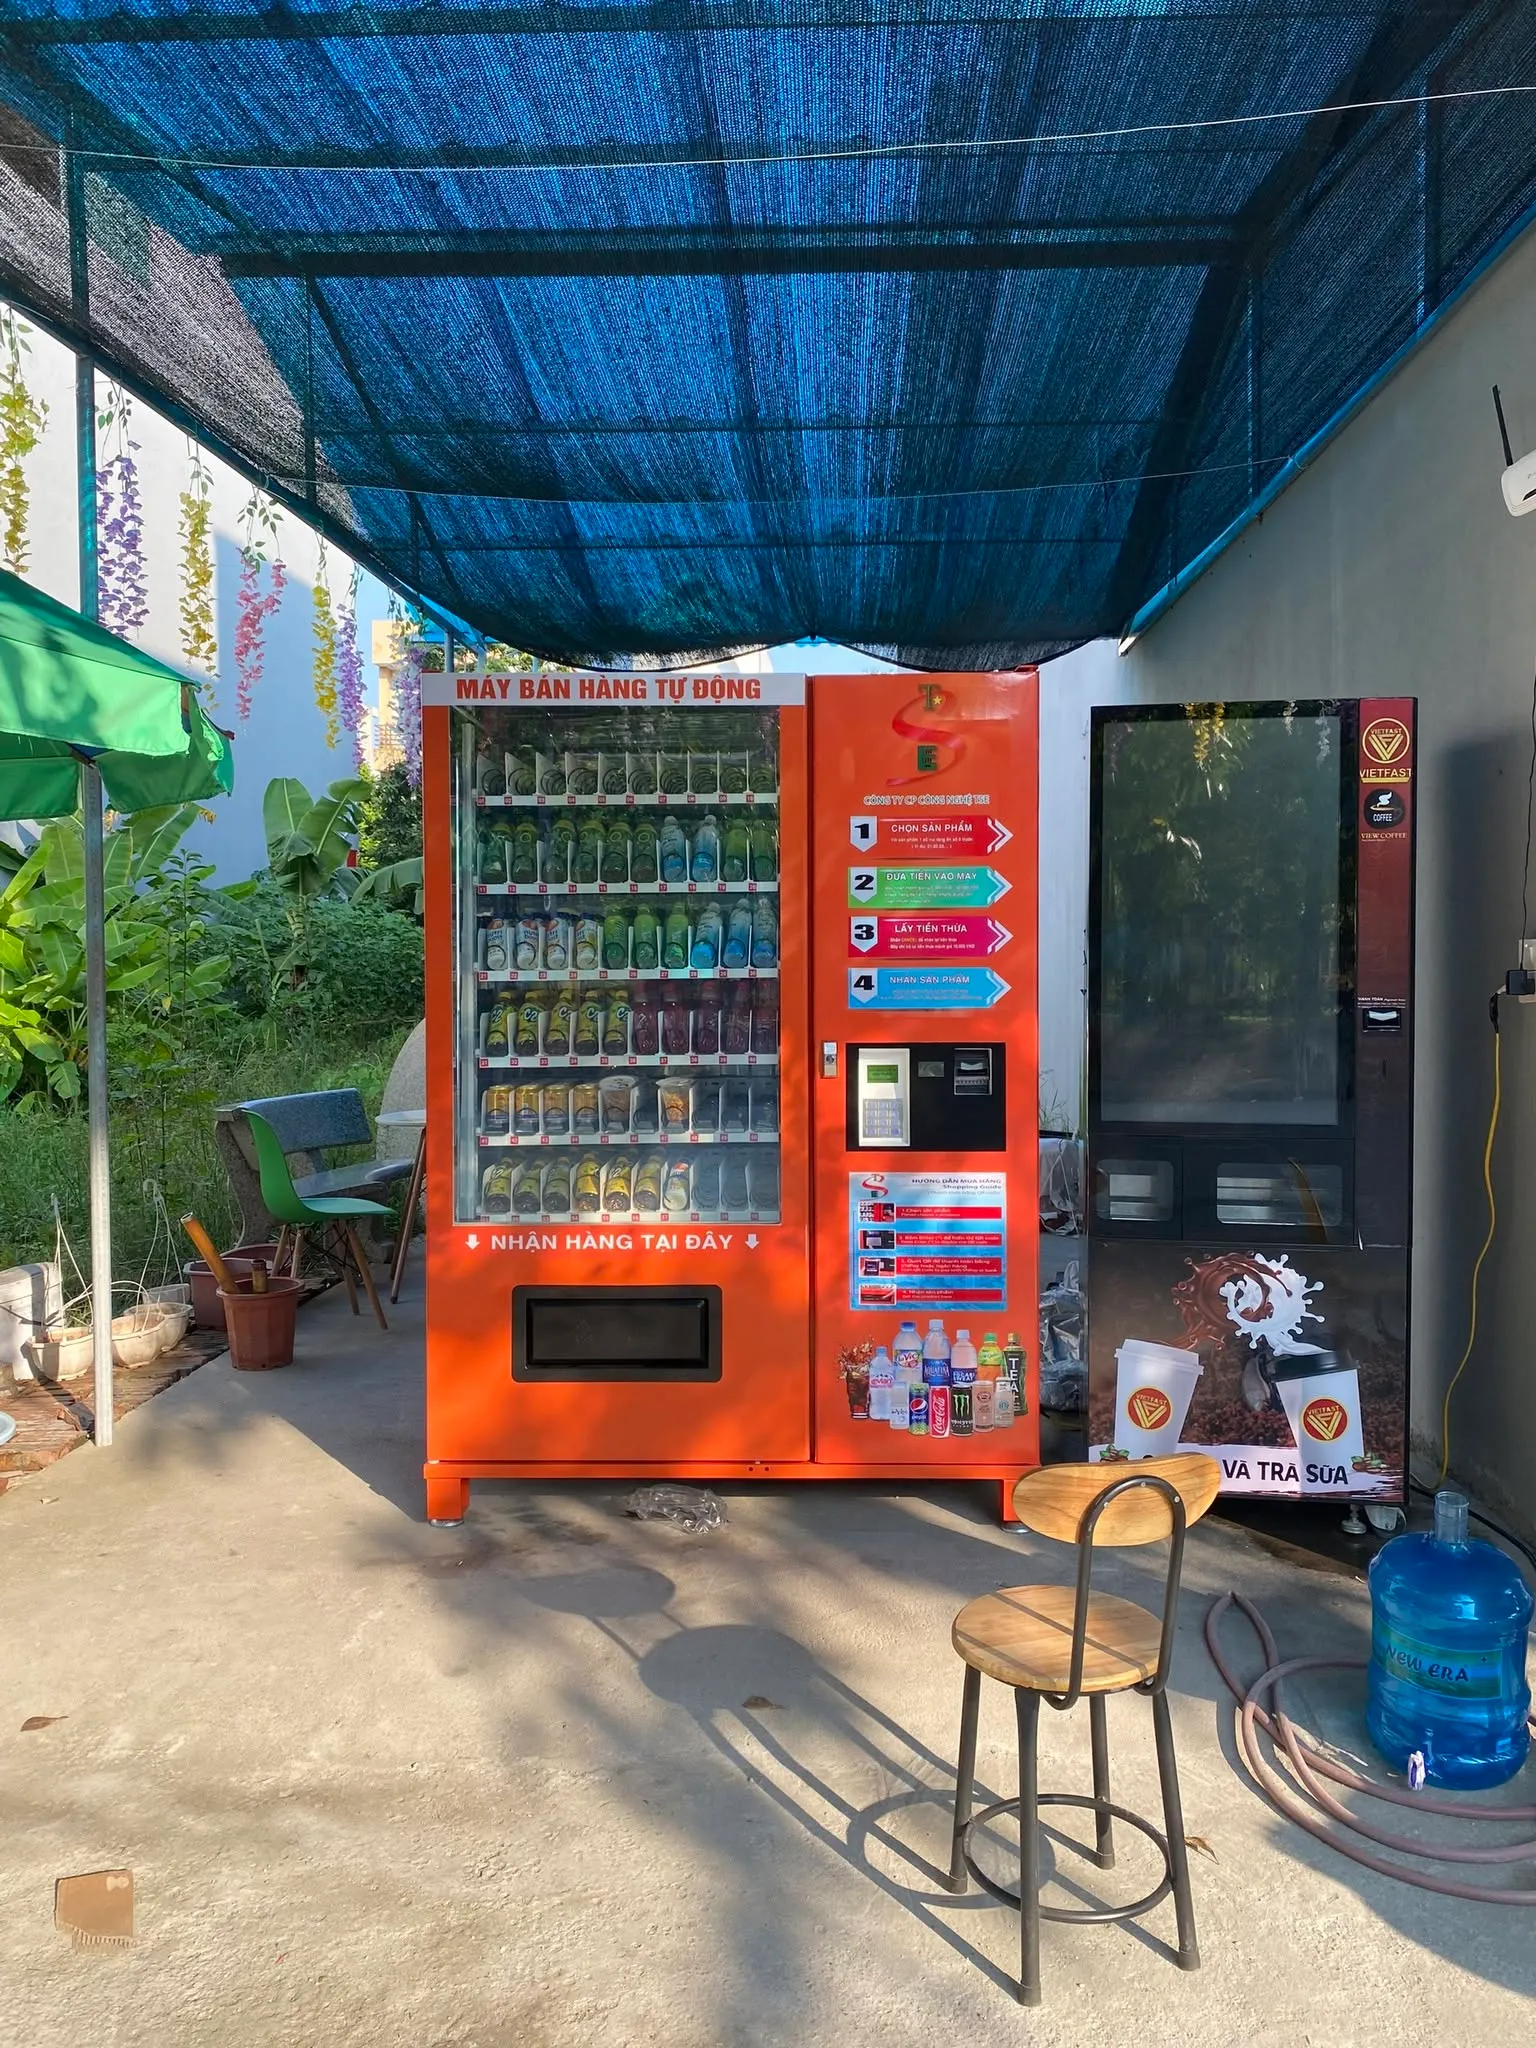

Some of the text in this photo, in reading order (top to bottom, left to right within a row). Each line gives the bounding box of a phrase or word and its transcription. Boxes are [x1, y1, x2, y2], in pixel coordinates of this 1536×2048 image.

[456, 675, 761, 704] MÁY BÁN HÀNG TỰ ĐỘNG
[1360, 768, 1412, 778] VIETFAST
[864, 794, 990, 806] CÔNG TY CP CÔNG NGHỆ TSE
[1373, 814, 1392, 822] COFFEE
[854, 823, 870, 839] 1
[891, 824, 918, 833] CHỌN
[922, 822, 942, 832] SẢN
[854, 874, 874, 890] 2
[854, 924, 874, 940] 3
[895, 922, 912, 932] LẤY
[854, 975, 875, 990] 4
[524, 1008, 538, 1021] C2
[491, 1231, 734, 1252] NHẬN HÀNG TẠI ĐÂY
[1136, 1393, 1167, 1406] VIETFAST
[1307, 1405, 1340, 1415] VIETFAST
[1222, 1459, 1349, 1485] VÀ TRÀ SỮA
[1386, 1646, 1469, 1682] NEW ERA
